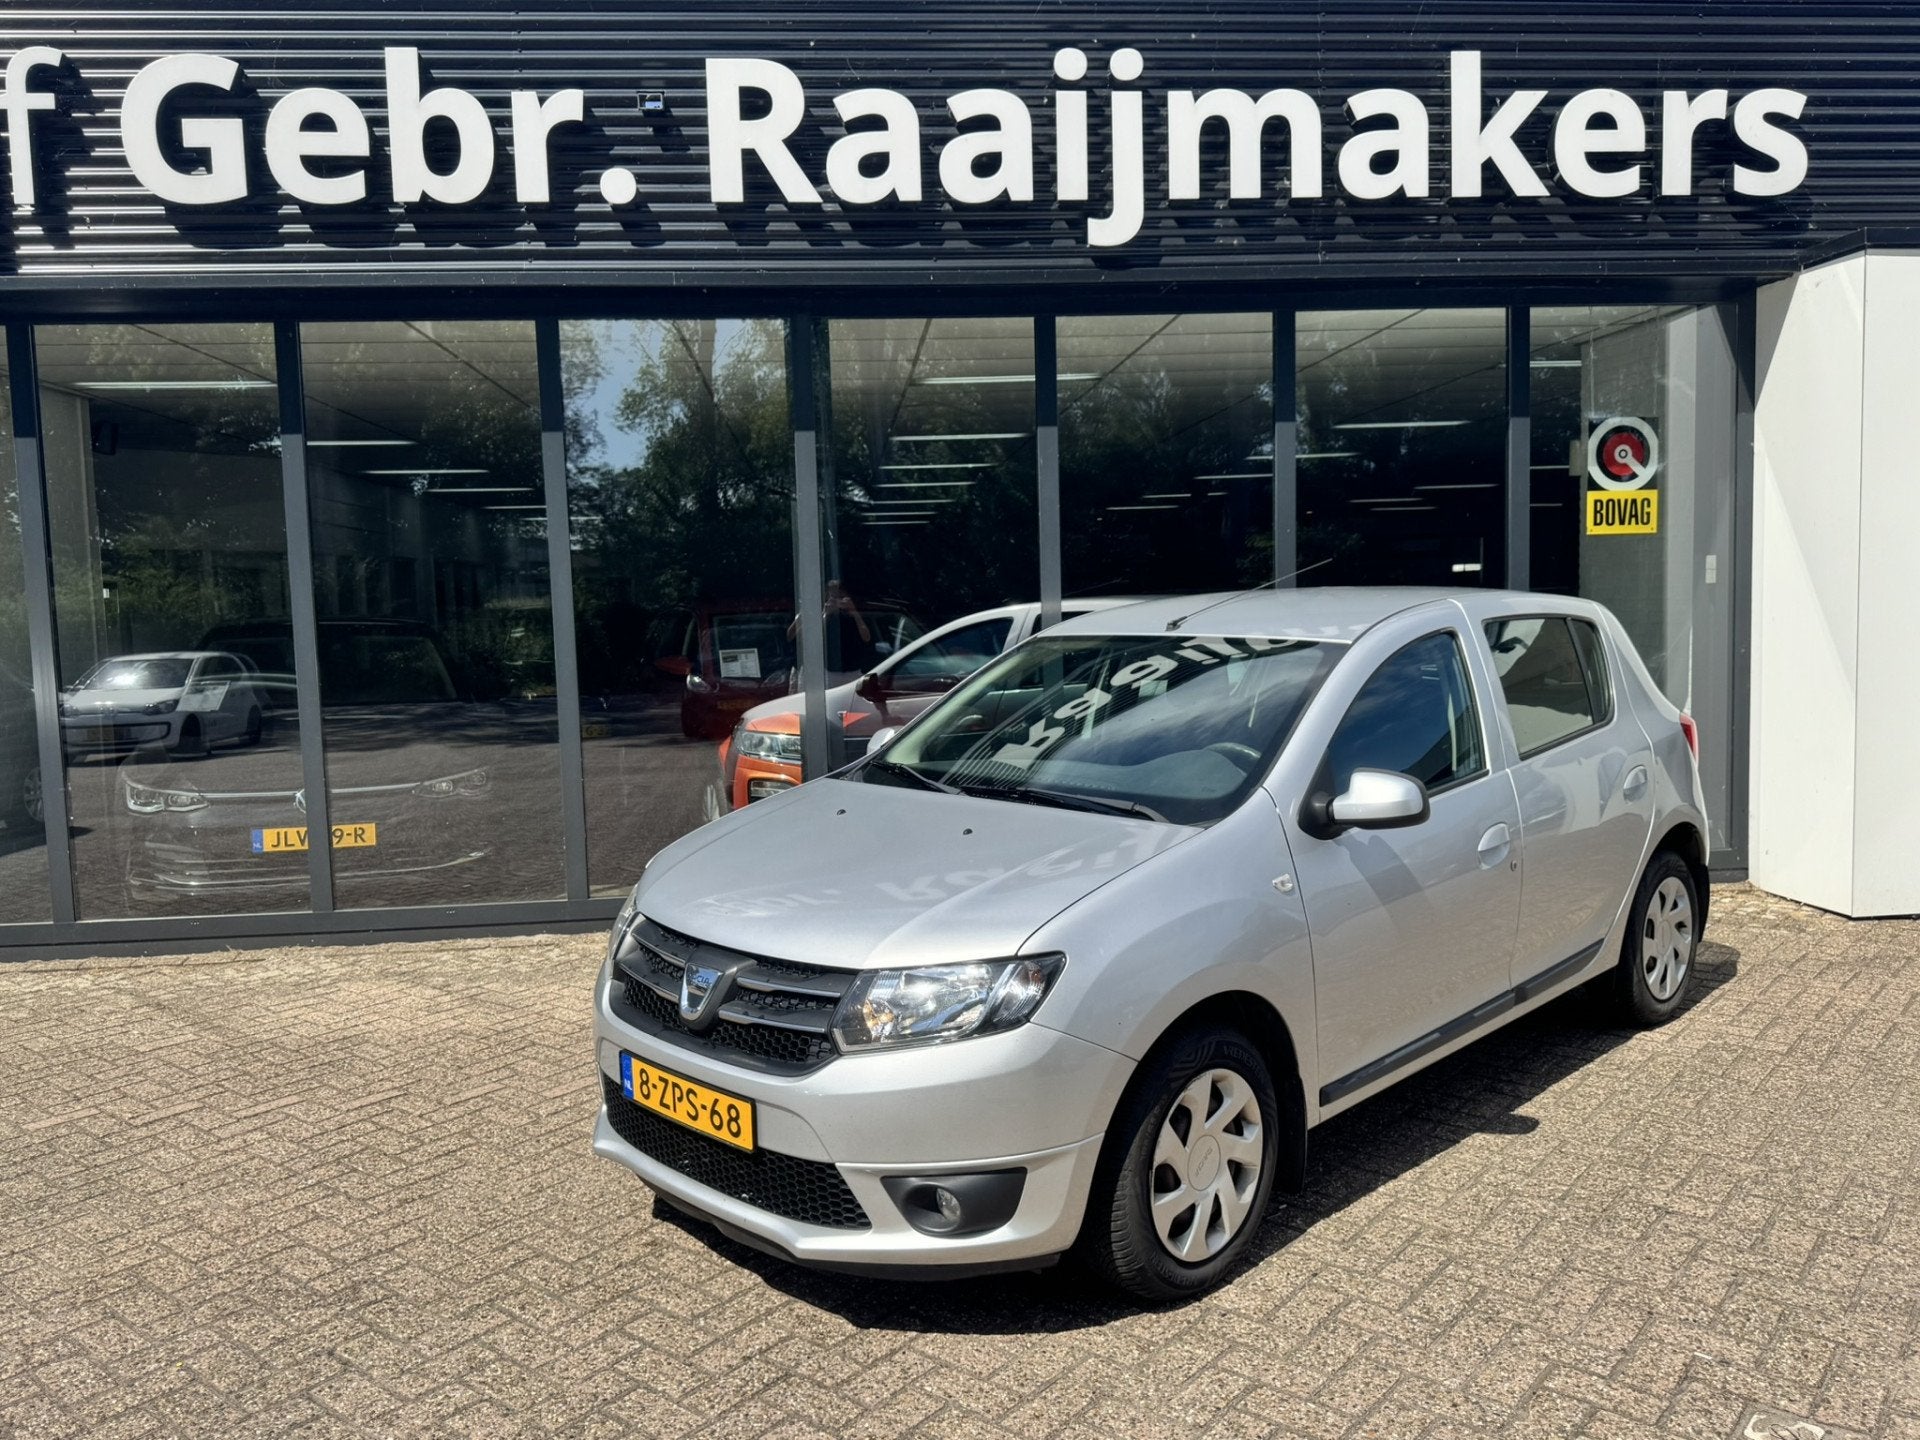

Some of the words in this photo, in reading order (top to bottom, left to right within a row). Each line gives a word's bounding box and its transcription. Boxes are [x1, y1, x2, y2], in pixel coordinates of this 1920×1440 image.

[120, 47, 637, 204] Gebr.
[705, 47, 1808, 247] Raaijmakers
[1593, 498, 1651, 526] BOVAG
[271, 826, 367, 848] JLV9-R
[624, 1079, 633, 1091] NL
[639, 1067, 742, 1139] 8-ZPS-68
